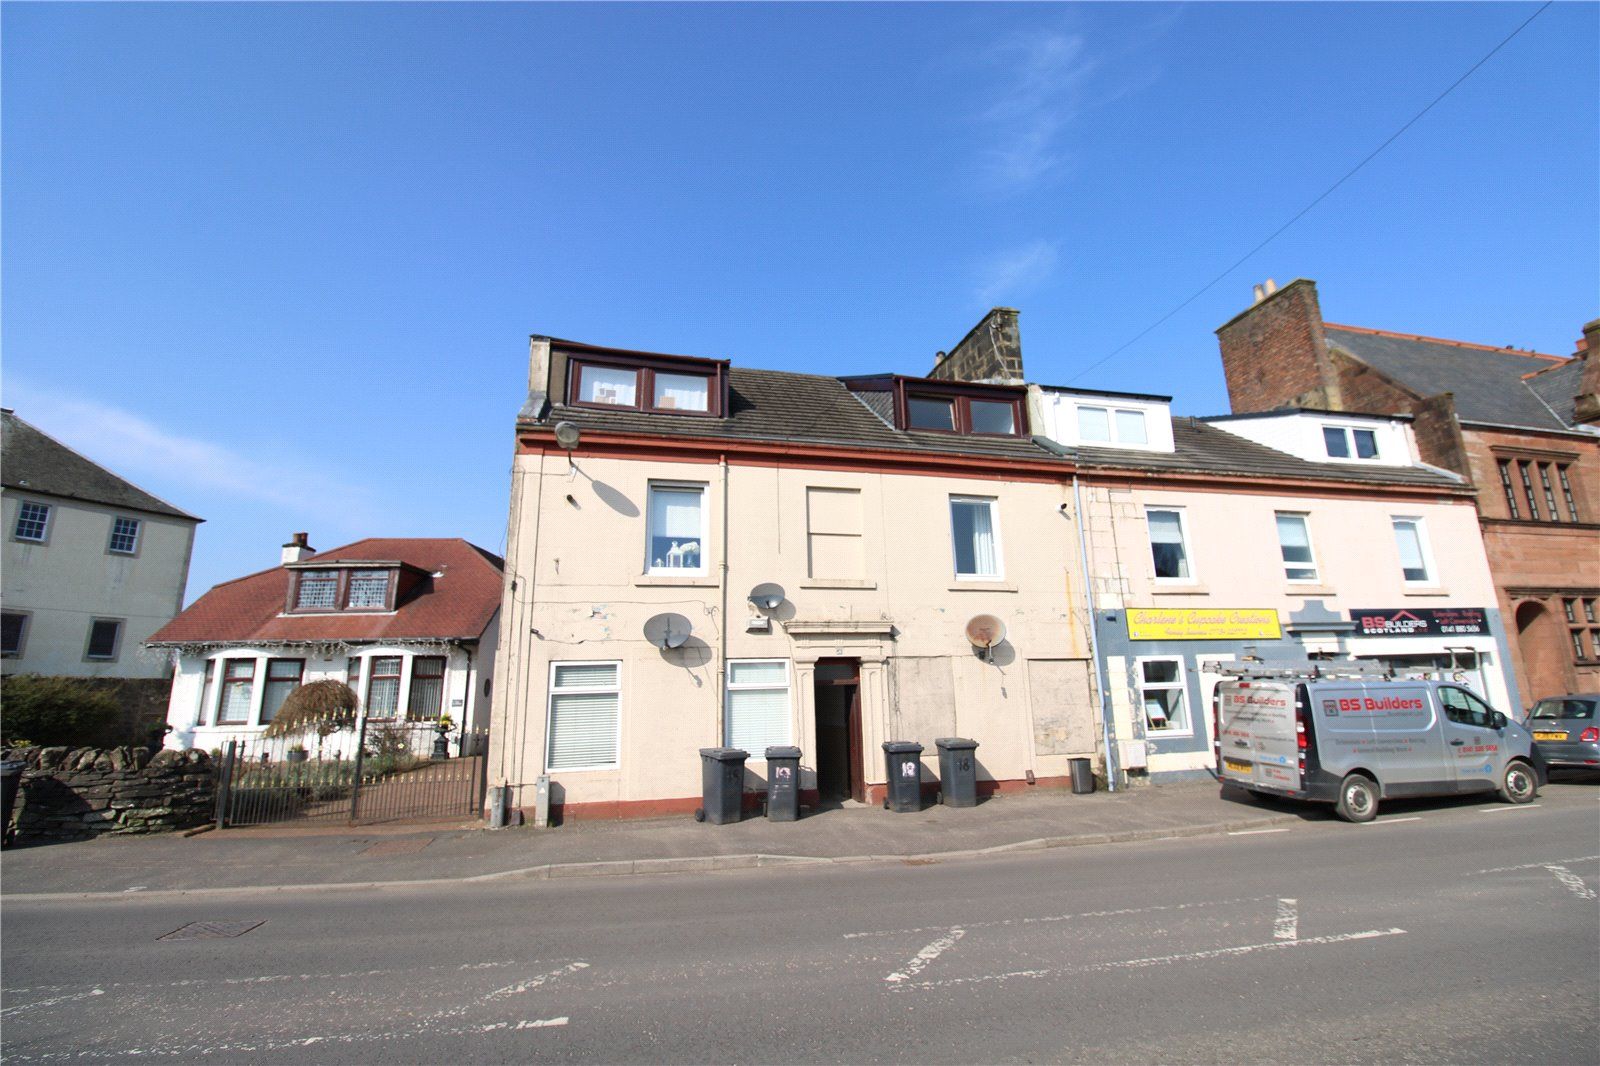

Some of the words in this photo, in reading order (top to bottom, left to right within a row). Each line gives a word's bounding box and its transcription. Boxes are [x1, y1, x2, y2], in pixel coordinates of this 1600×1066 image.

[1134, 611, 1185, 625] Charlene's
[1187, 611, 1227, 628] Cupcake
[1230, 611, 1271, 625] Creations
[1361, 616, 1385, 629] BS
[1385, 620, 1428, 628] BUILDERS
[1233, 695, 1246, 704] BS
[1247, 695, 1287, 707] Builders
[1339, 698, 1362, 711] BS
[1364, 696, 1424, 710] Builders
